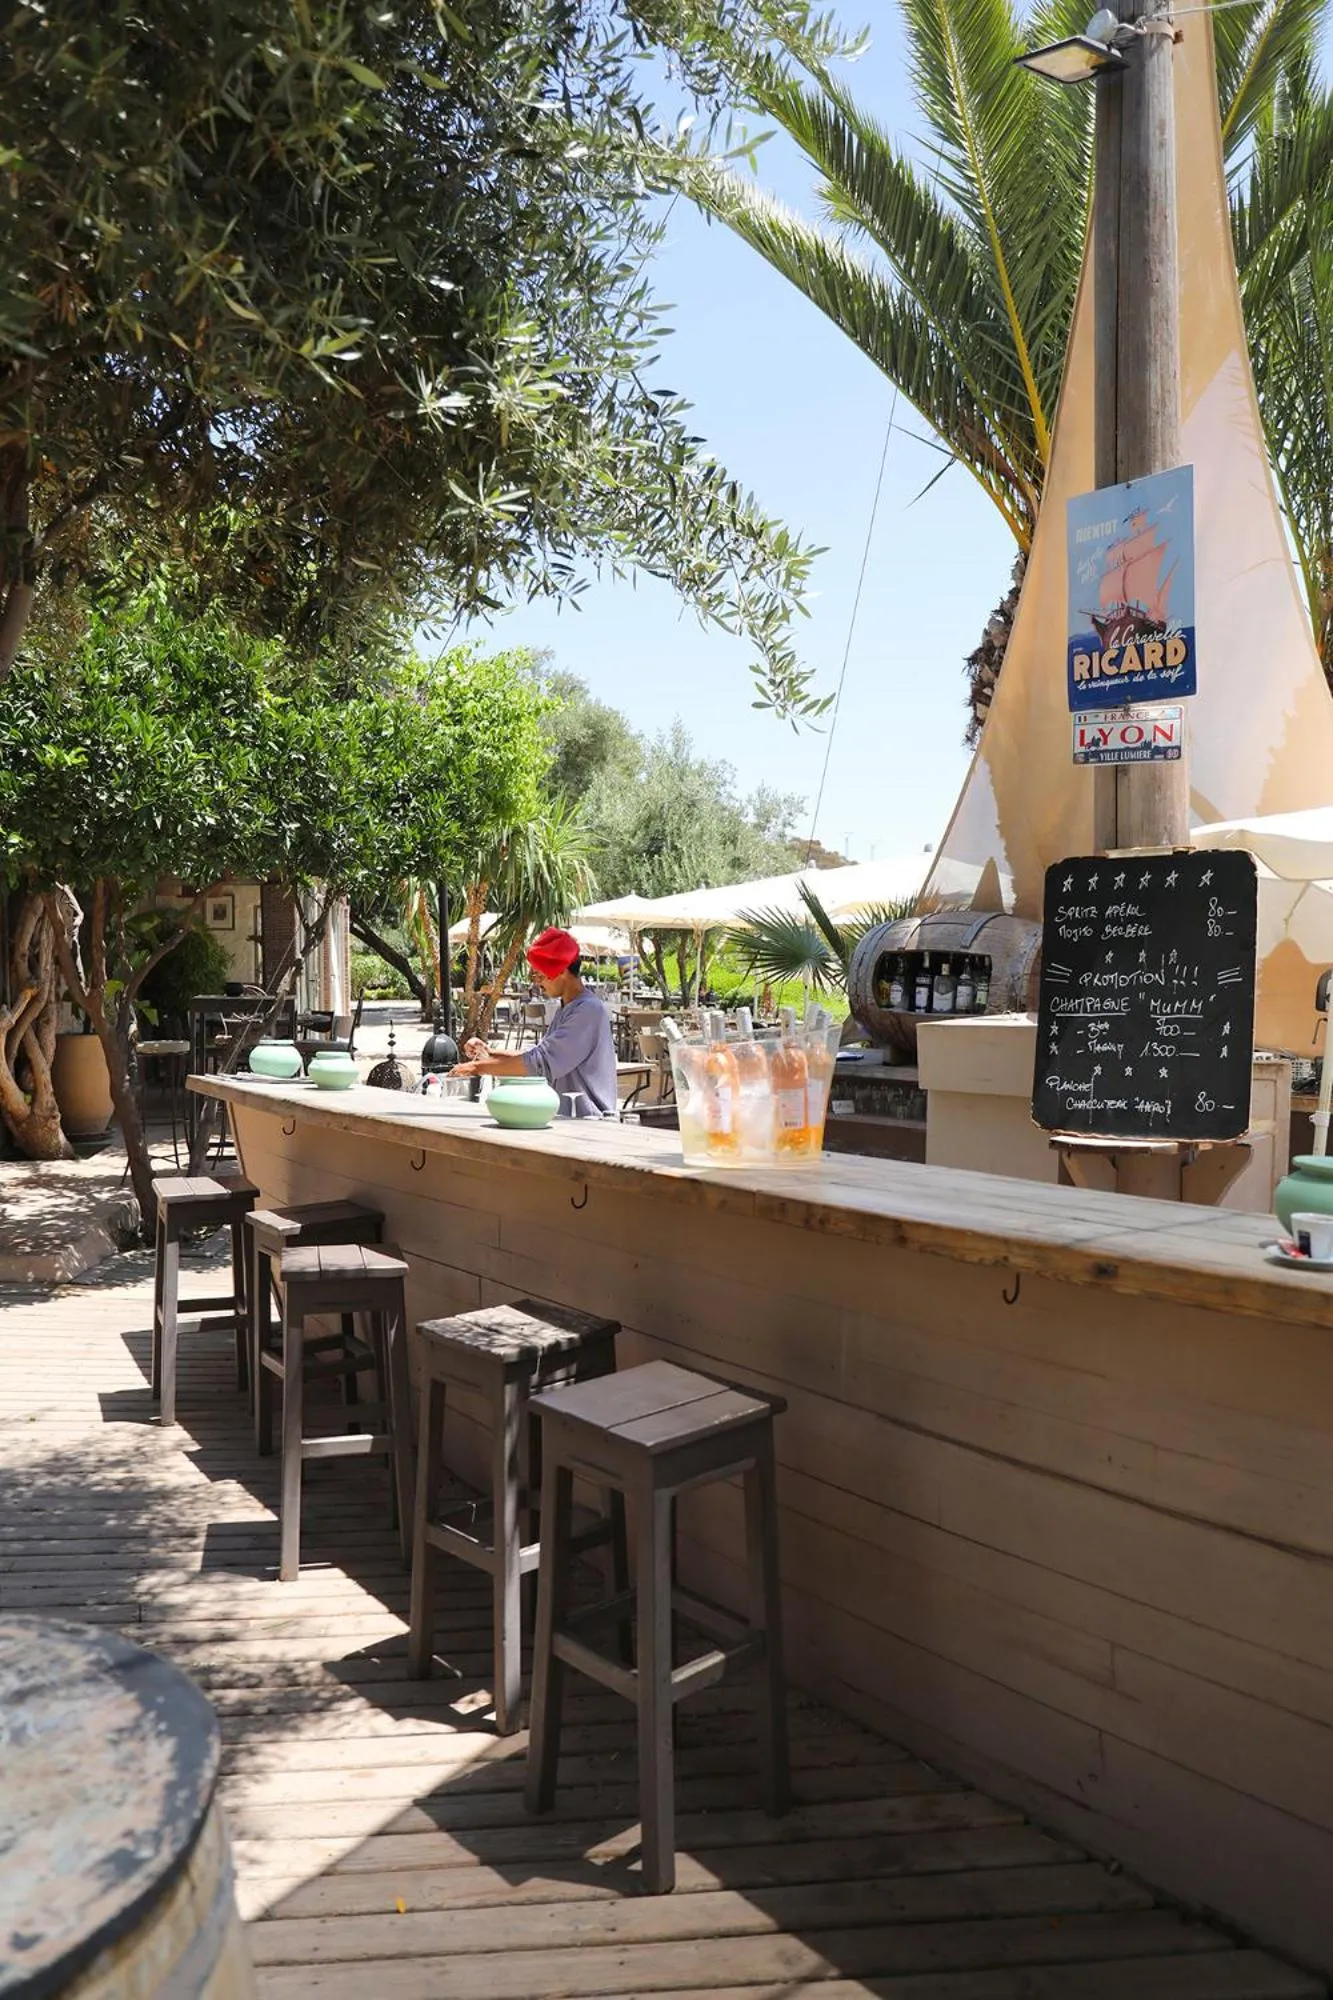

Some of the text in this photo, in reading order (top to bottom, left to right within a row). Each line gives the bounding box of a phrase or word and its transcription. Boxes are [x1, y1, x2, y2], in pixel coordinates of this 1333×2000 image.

[1073, 638, 1187, 682] RICARD
[1132, 671, 1145, 683] de
[1103, 711, 1151, 722] FRANCE
[1079, 723, 1174, 748] LYON
[1099, 751, 1119, 761] VILLE
[1049, 996, 1131, 1014] CHAMPAGNE
